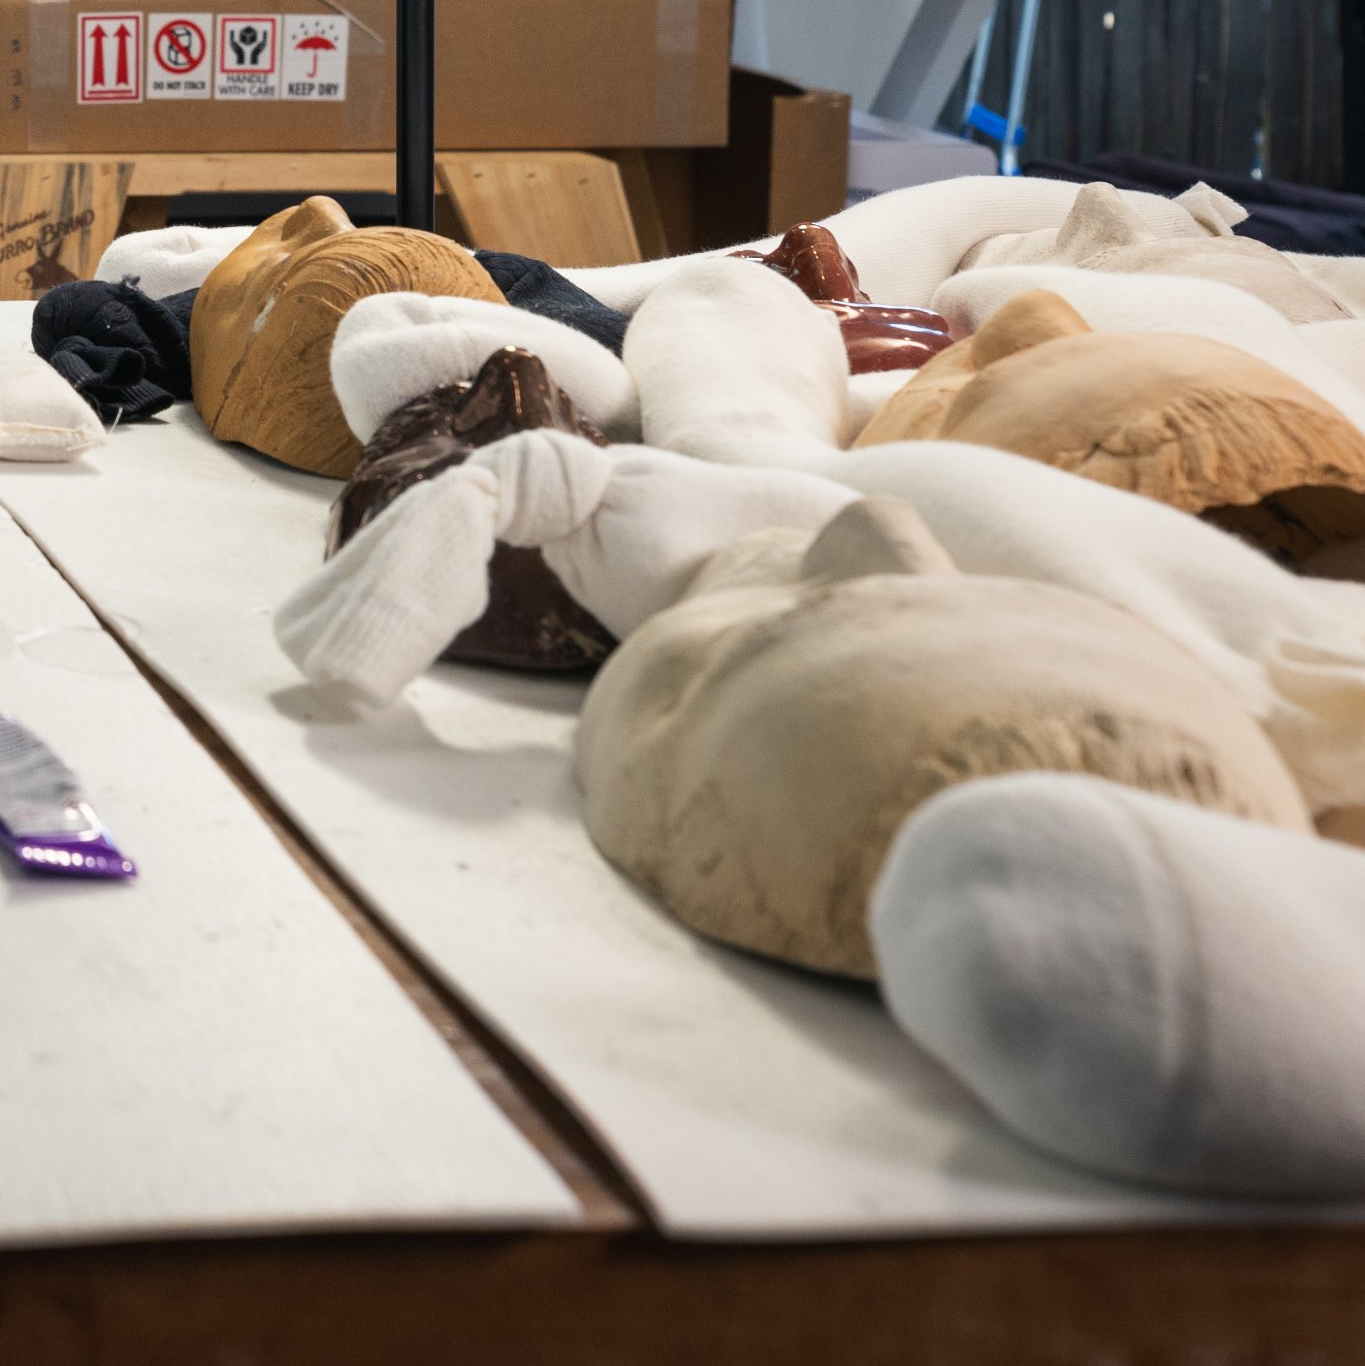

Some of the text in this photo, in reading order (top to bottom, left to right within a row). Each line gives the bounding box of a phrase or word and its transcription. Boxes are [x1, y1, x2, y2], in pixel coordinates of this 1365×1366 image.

[226, 74, 268, 84] HANDLE
[152, 80, 164, 91] DO
[166, 80, 181, 90] NOT
[219, 85, 275, 96] WITH CARE
[287, 83, 339, 95] KEEP DRY
[39, 209, 95, 246] BRAND
